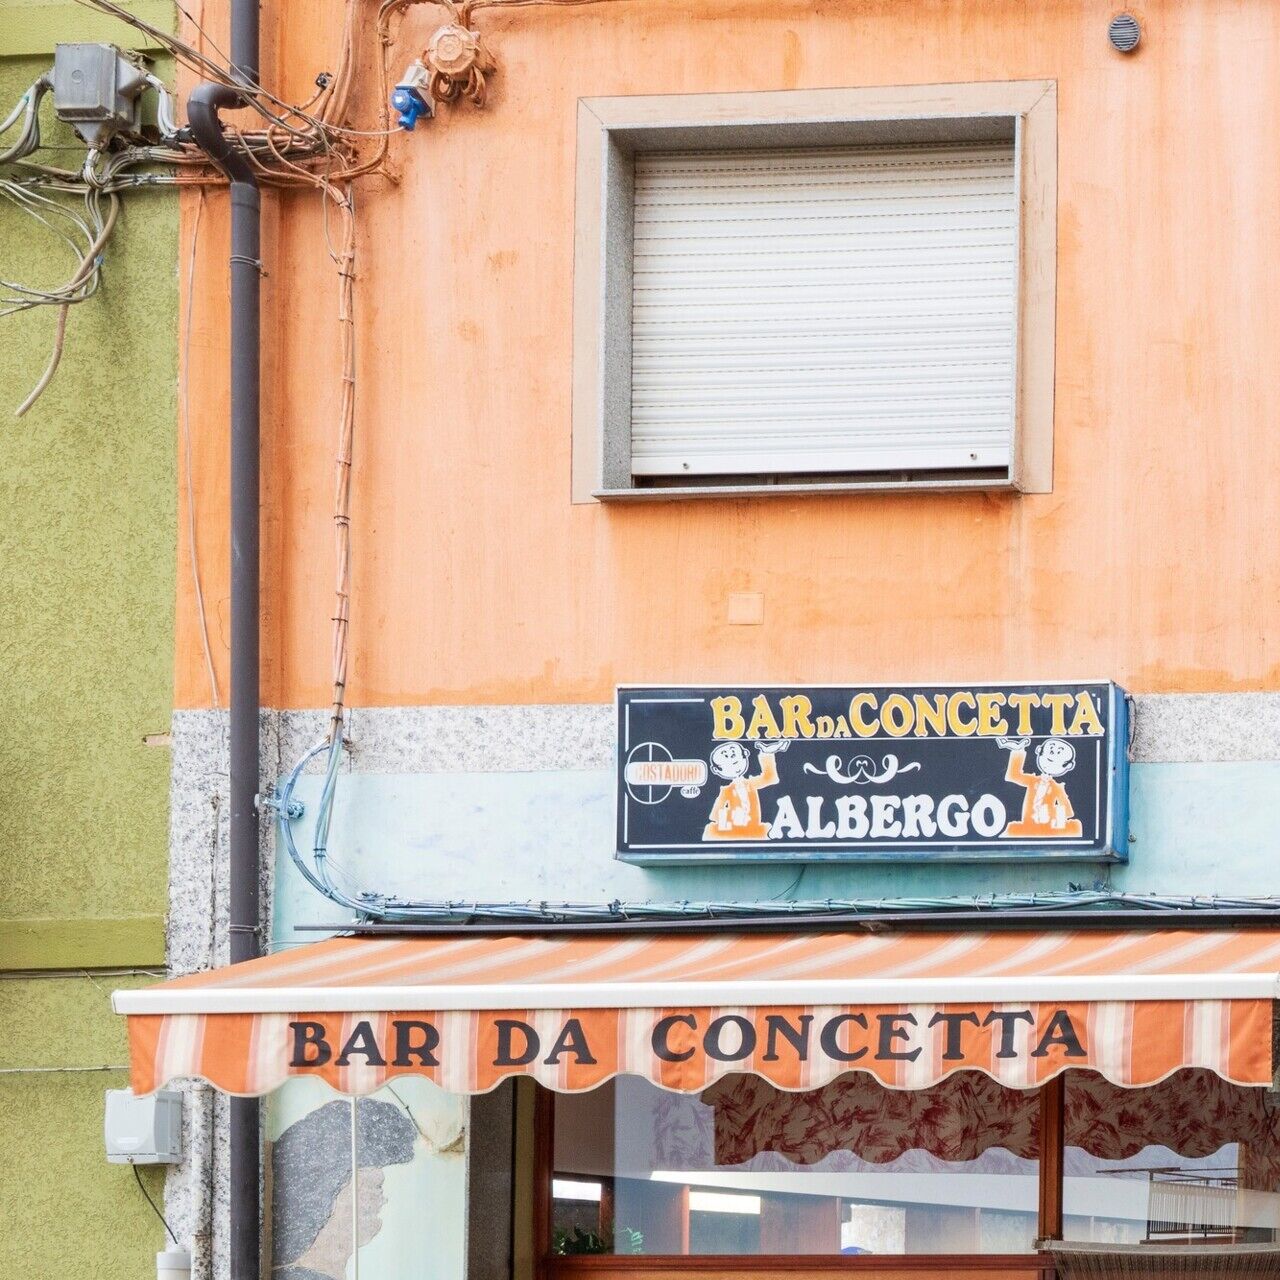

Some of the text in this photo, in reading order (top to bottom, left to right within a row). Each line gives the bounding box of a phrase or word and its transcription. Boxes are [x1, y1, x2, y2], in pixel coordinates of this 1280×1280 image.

[710, 691, 1104, 739] BAR DA CONCETTA
[769, 794, 1006, 839] ALBERGO
[288, 1010, 1088, 1067] BAR DA CONCETTA
